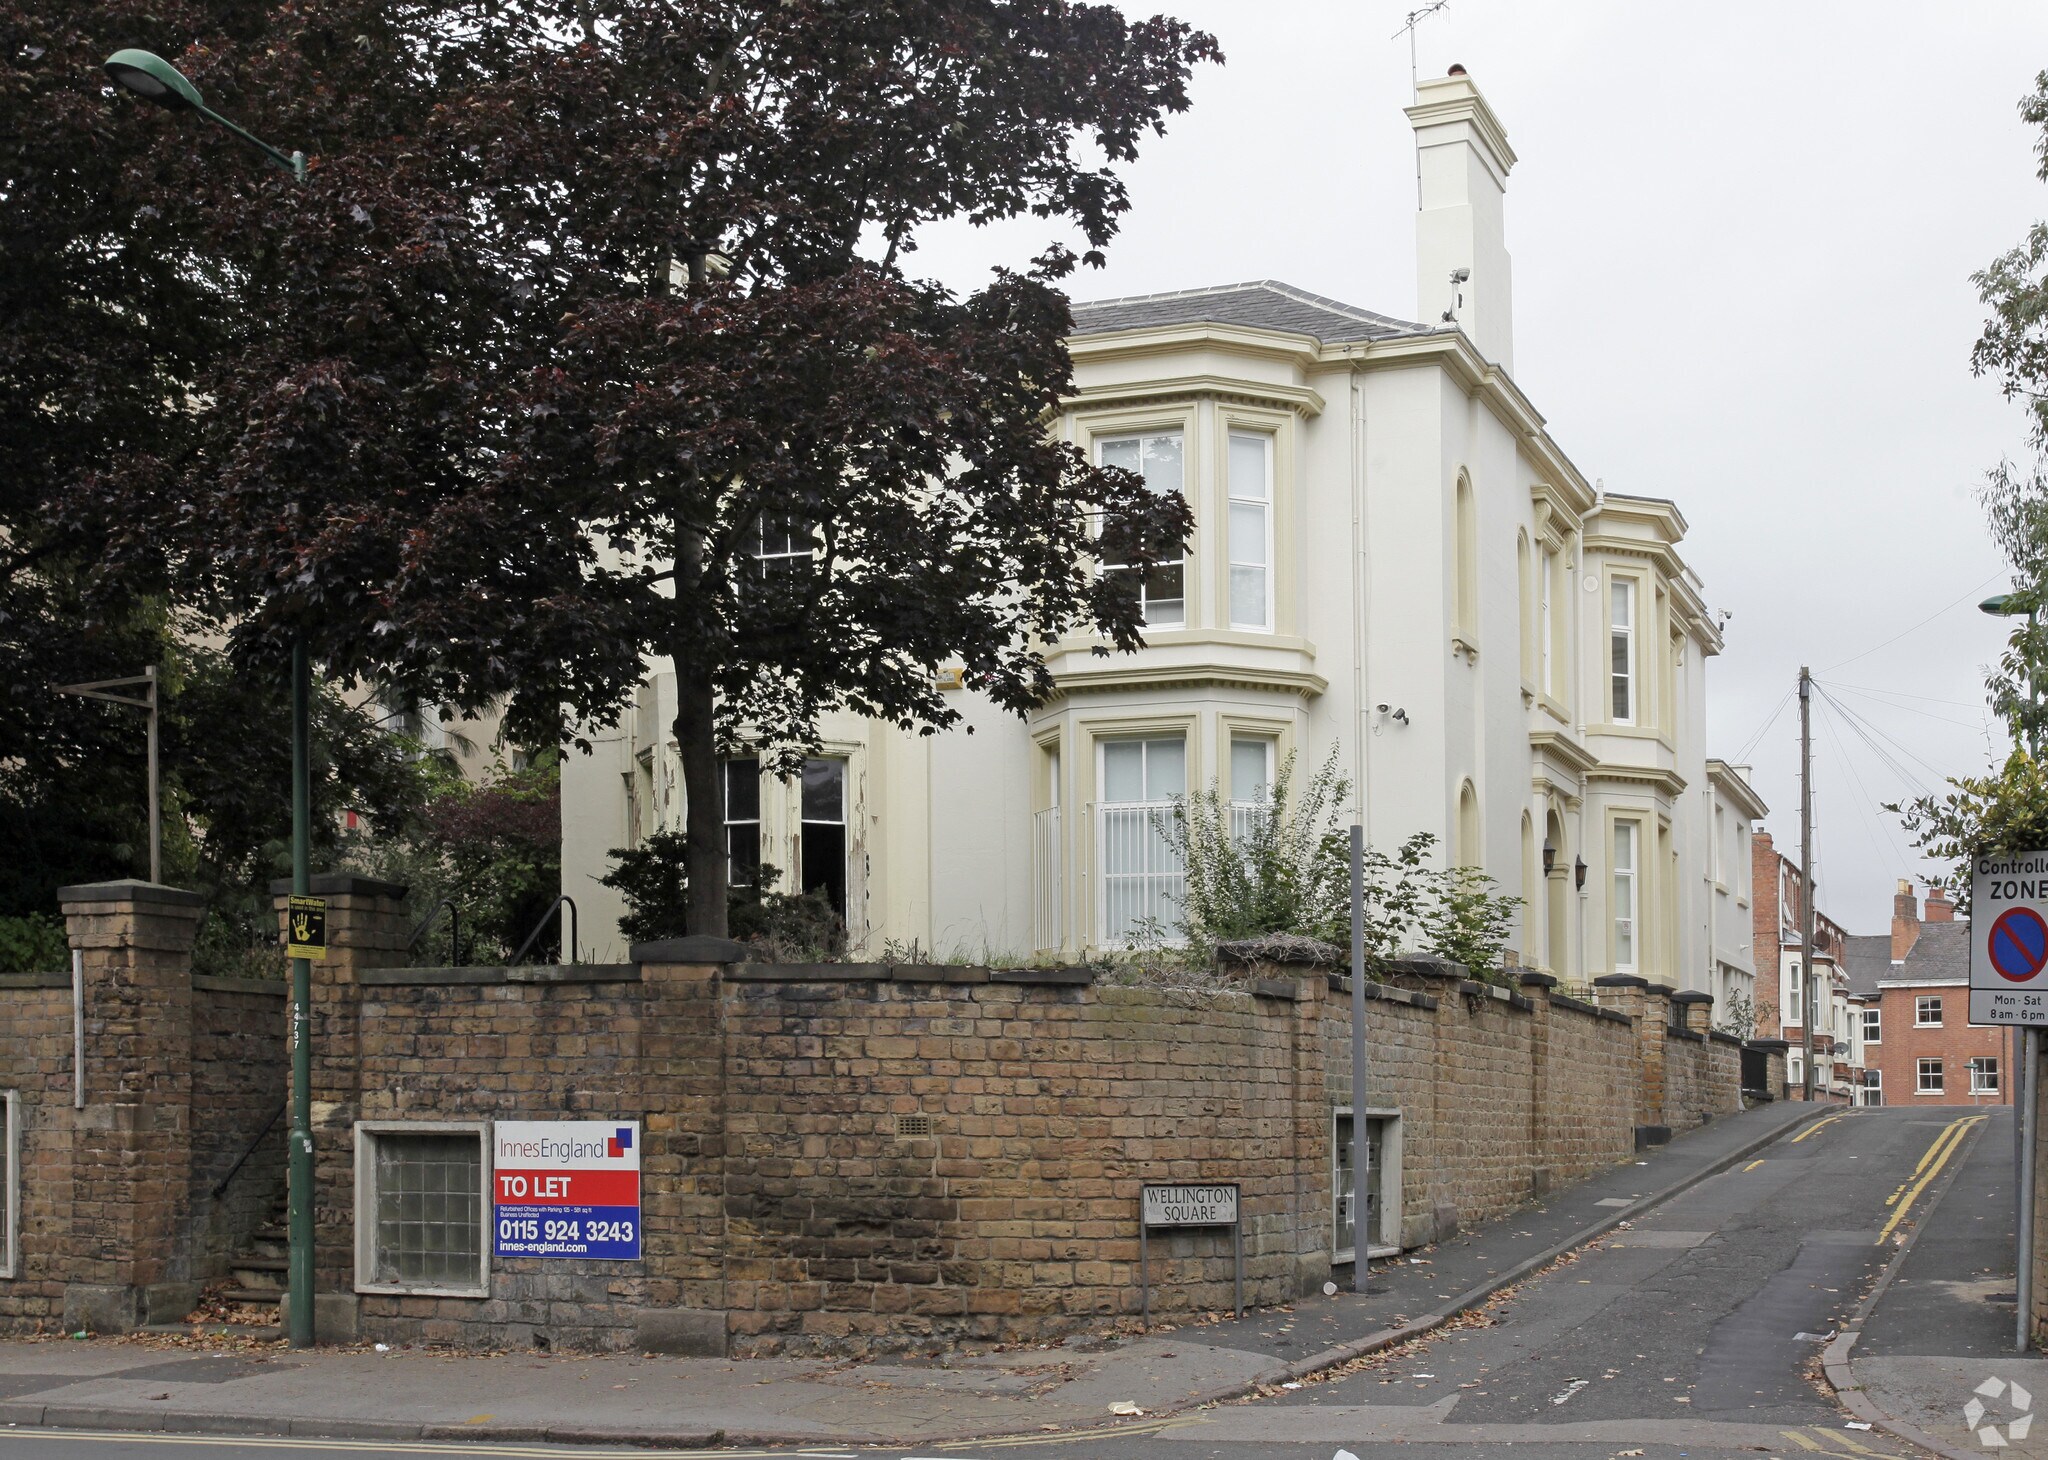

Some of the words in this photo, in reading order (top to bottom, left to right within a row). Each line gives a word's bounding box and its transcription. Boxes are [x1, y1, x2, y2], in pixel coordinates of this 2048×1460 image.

[1979, 858, 2048, 875] Controll
[1990, 880, 2048, 899] ZONE
[290, 896, 325, 907] SmartWater
[1995, 995, 2015, 1005] Mon
[2024, 995, 2041, 1005] Sat
[500, 1176, 528, 1197] TO
[534, 1176, 571, 1198] LET
[1147, 1188, 1233, 1203] WELLINGTON
[1164, 1206, 1216, 1221] SQUARE
[500, 1219, 538, 1240] 0115
[544, 1220, 580, 1241] 924
[586, 1221, 634, 1242] 3243
[500, 1241, 587, 1254] innes-england.com
